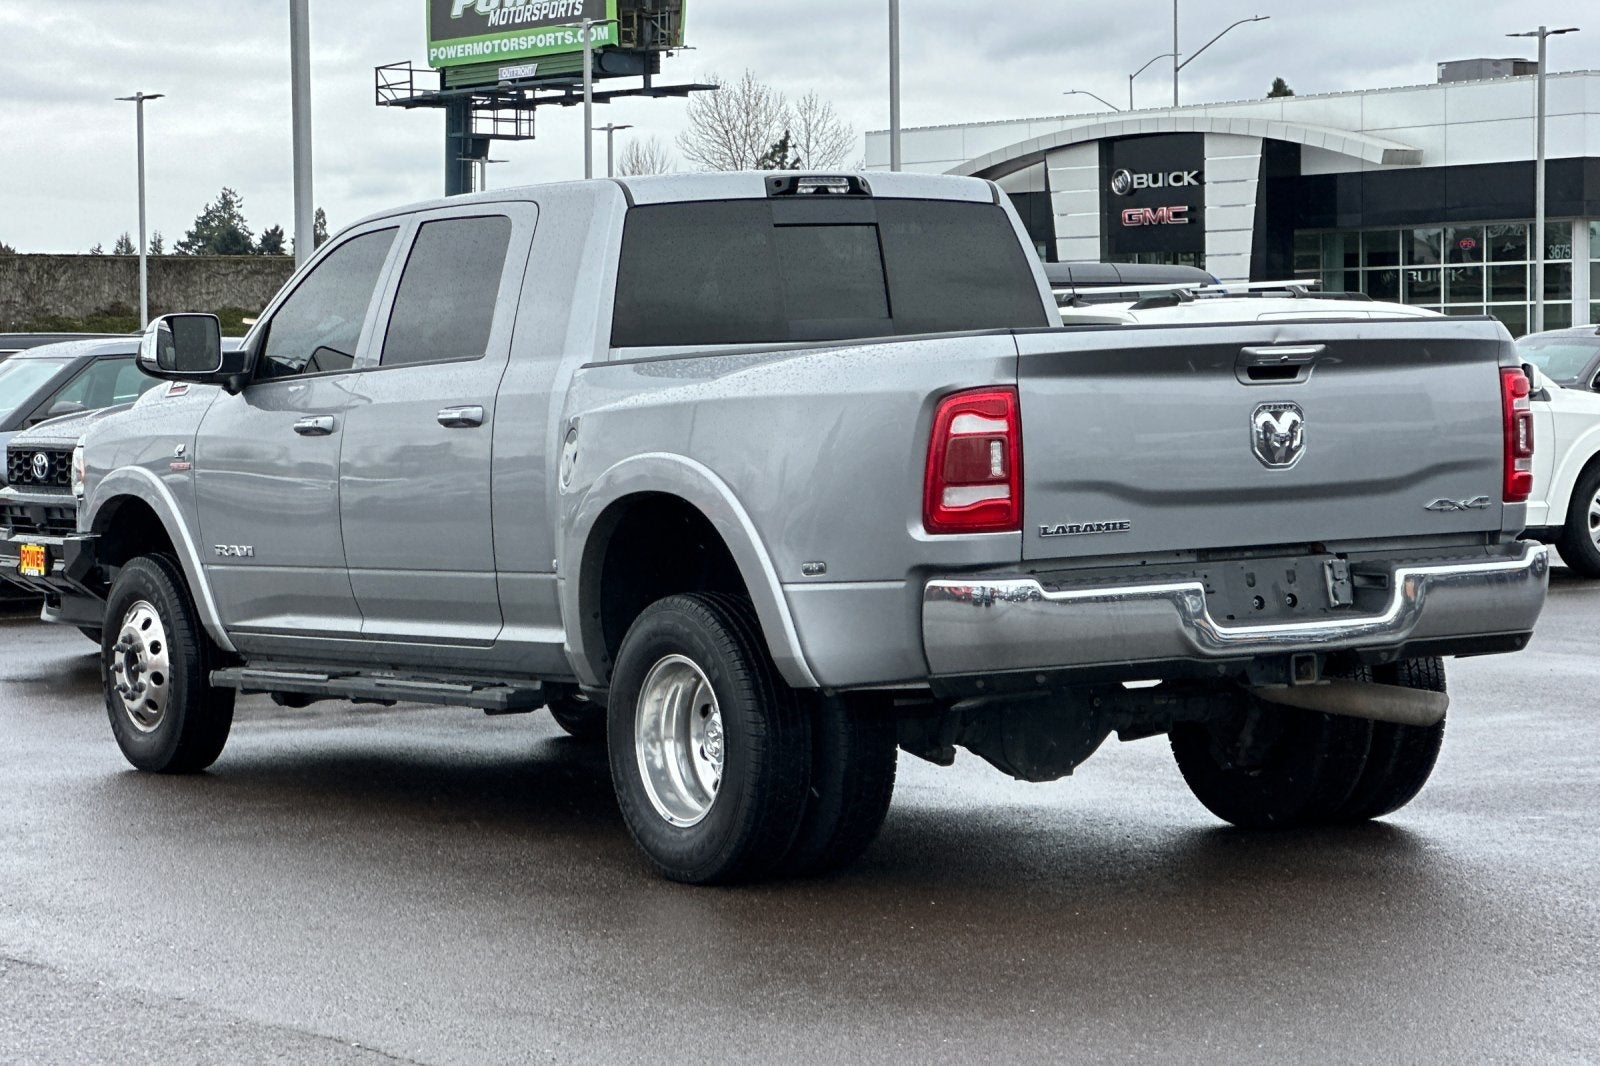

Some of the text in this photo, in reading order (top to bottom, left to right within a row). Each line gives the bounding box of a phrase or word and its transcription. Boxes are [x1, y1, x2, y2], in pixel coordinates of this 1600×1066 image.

[487, 0, 584, 27] MOTORSPORTS
[1133, 170, 1199, 189] BUICK
[1121, 205, 1189, 227] GMC
[1548, 244, 1571, 259] 3675
[1040, 520, 1131, 537] LARAMIE
[20, 549, 45, 568] POWER
[214, 544, 254, 557] RAM
